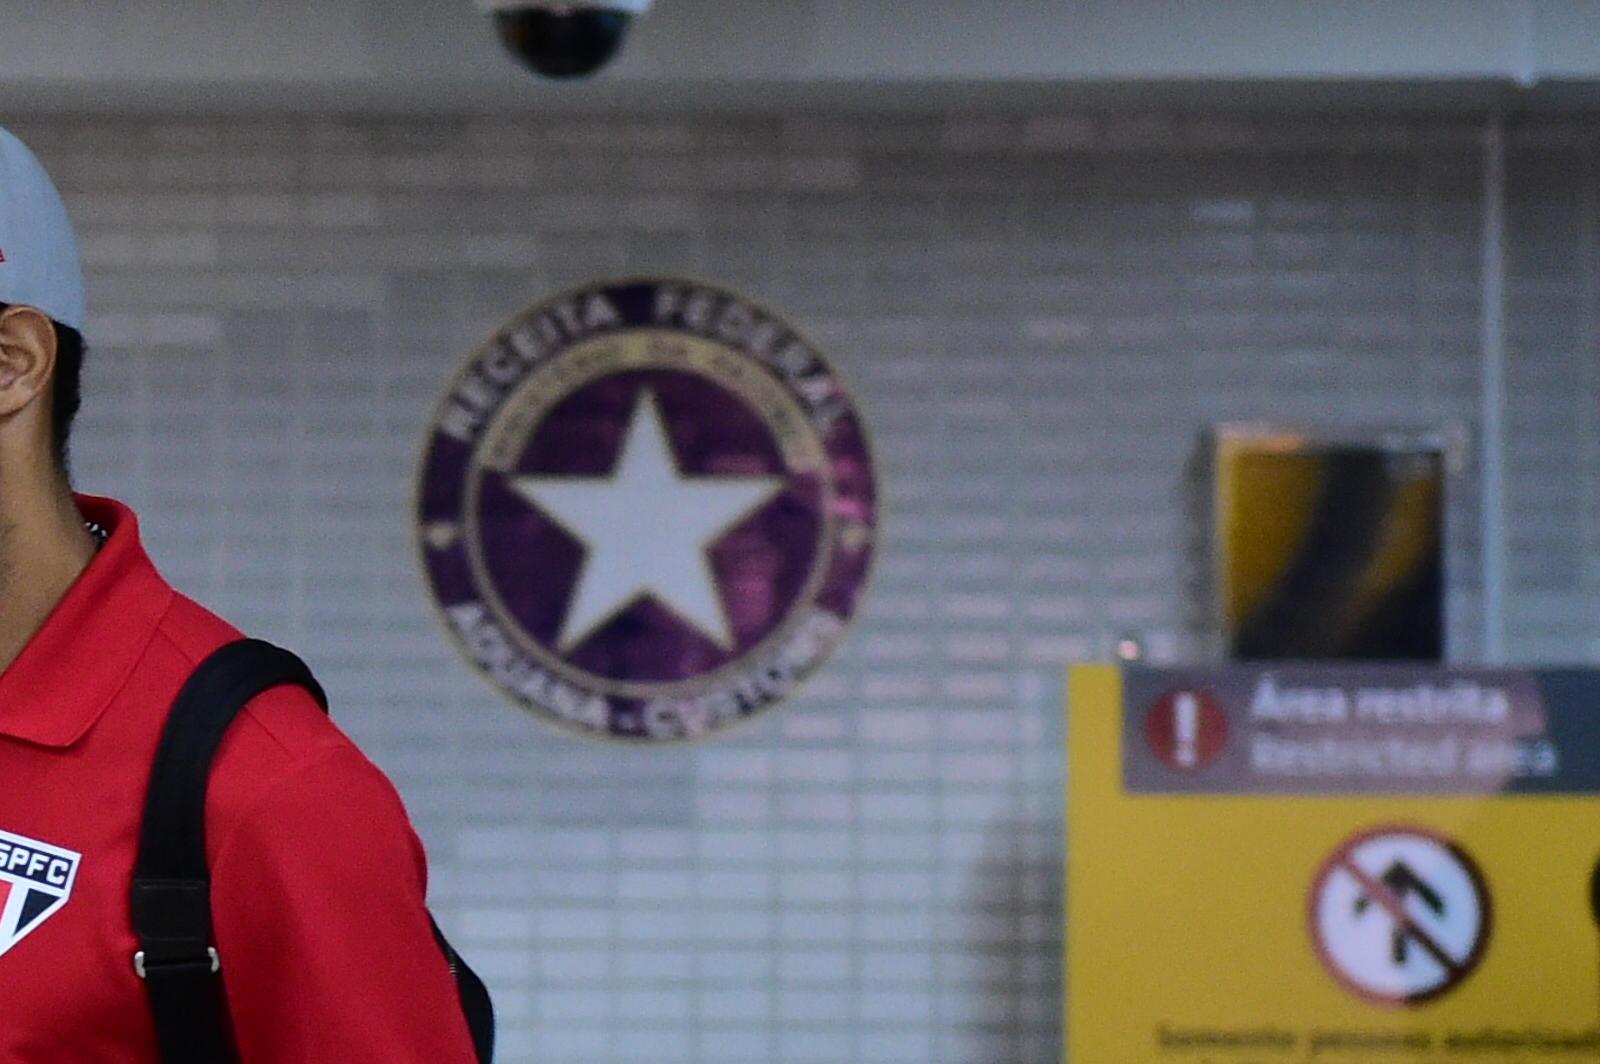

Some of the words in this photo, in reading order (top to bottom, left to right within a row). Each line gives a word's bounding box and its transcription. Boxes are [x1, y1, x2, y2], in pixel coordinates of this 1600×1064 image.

[440, 295, 620, 440] RECEITA
[653, 288, 848, 438] FEDERAL
[447, 603, 609, 731] ADUANA
[1252, 672, 1348, 720] Área
[1355, 680, 1510, 723] restrita
